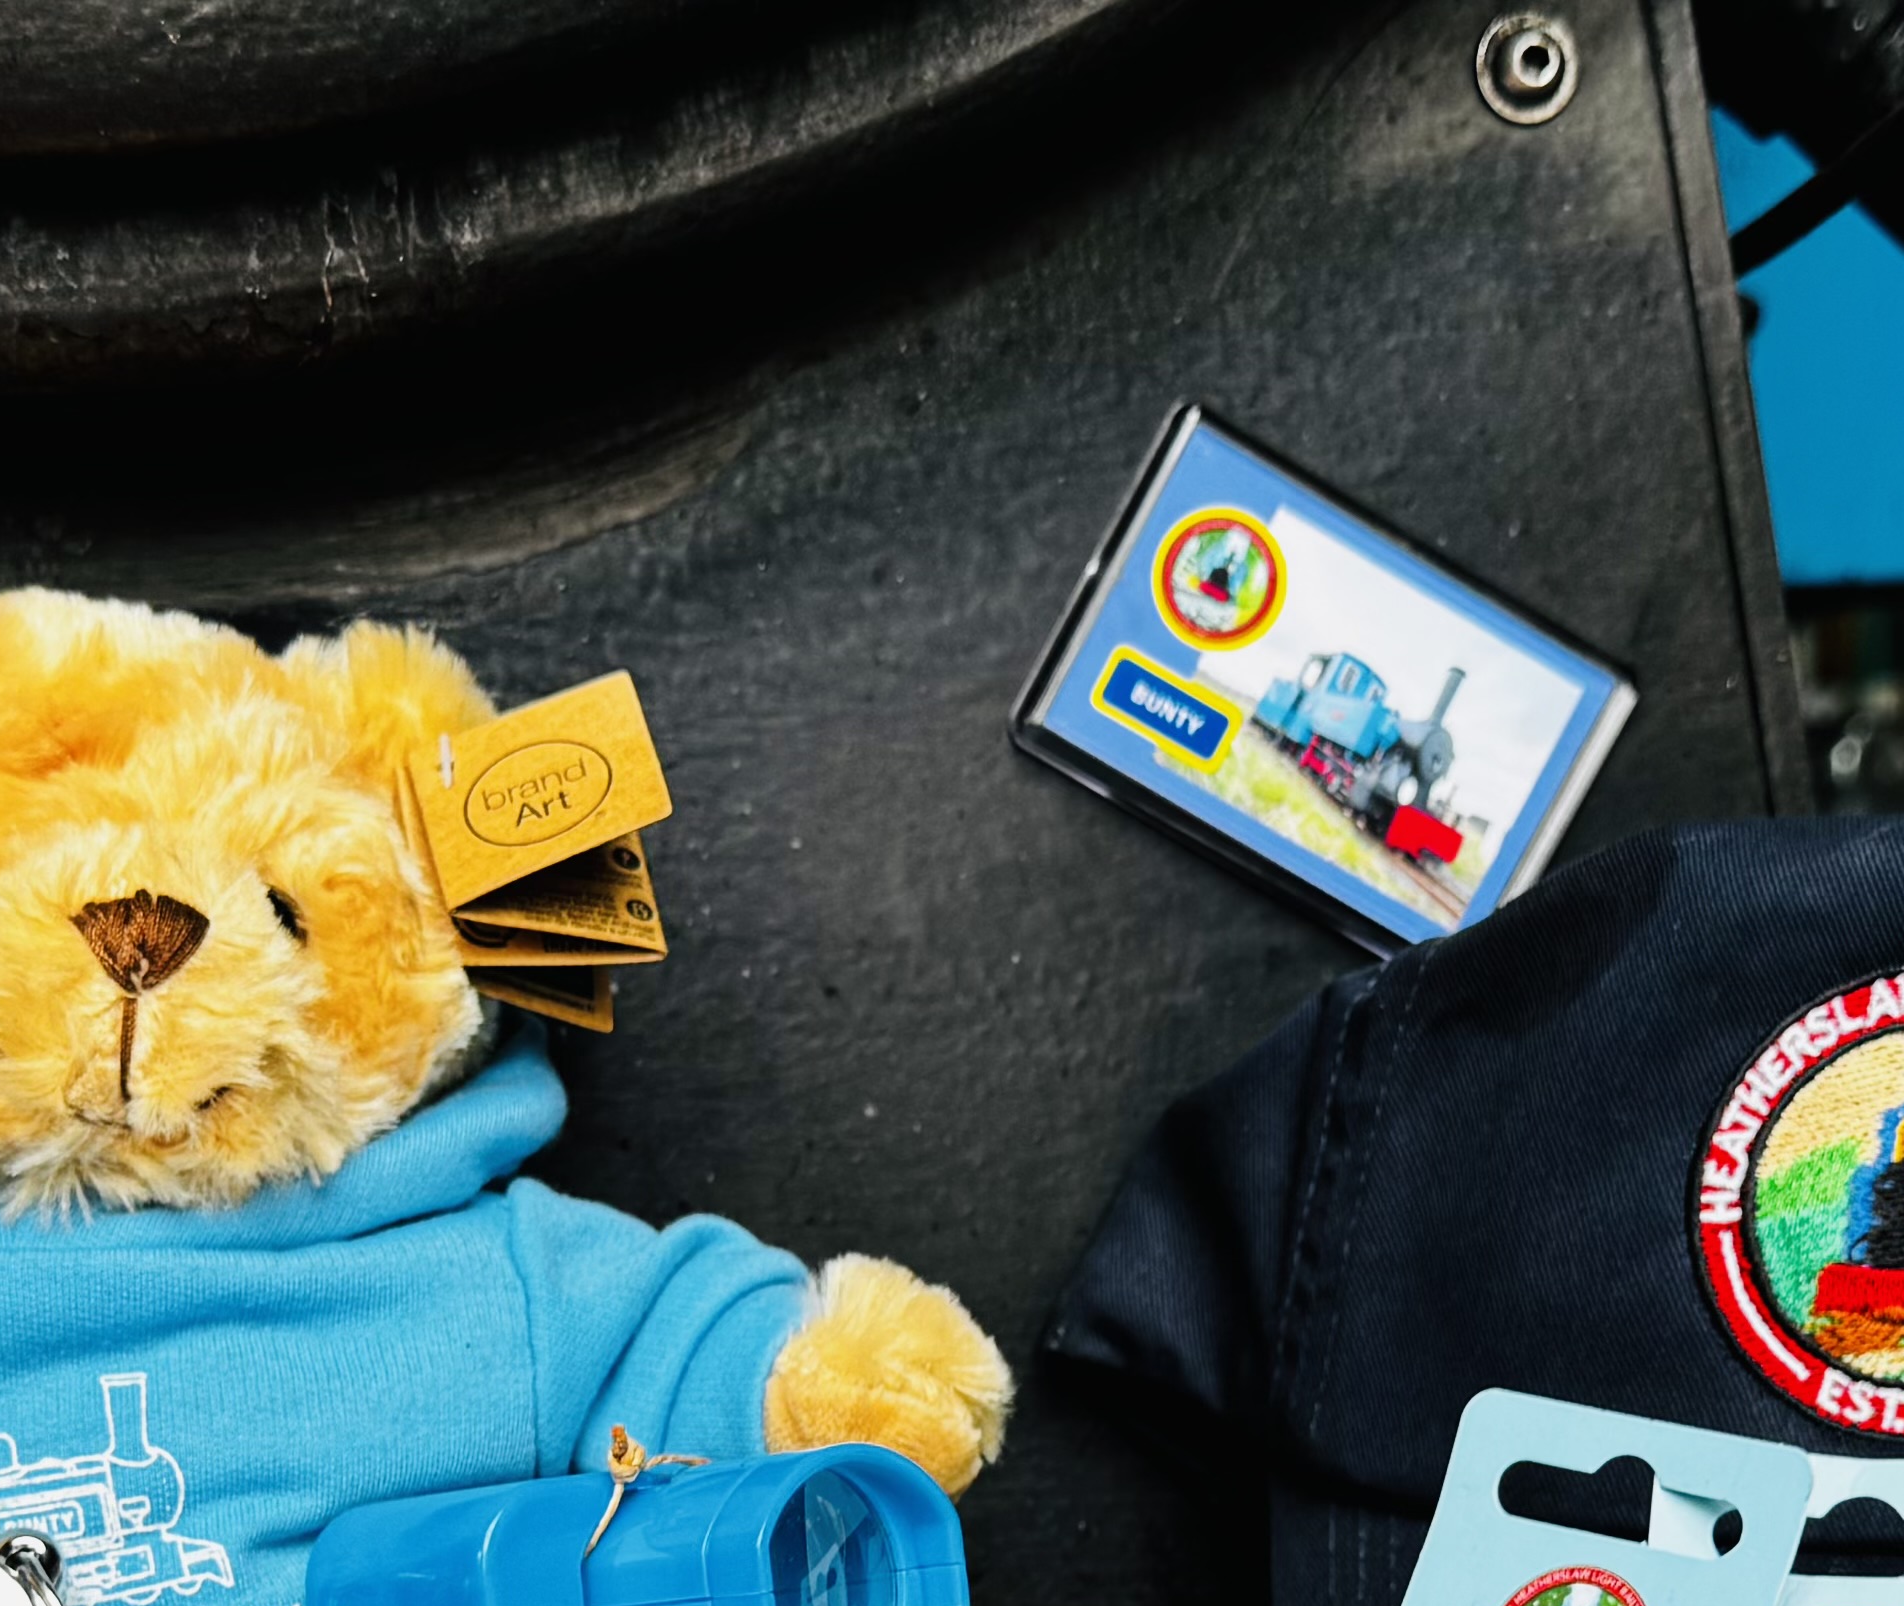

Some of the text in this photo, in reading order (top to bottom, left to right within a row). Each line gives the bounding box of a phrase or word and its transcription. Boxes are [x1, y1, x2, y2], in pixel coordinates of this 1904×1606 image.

[1129, 679, 1206, 736] BUNTY
[481, 756, 588, 812] brand
[516, 790, 574, 828] Art
[4, 1510, 75, 1534] BUNTY
[1591, 1569, 1623, 1591] LIGHT
